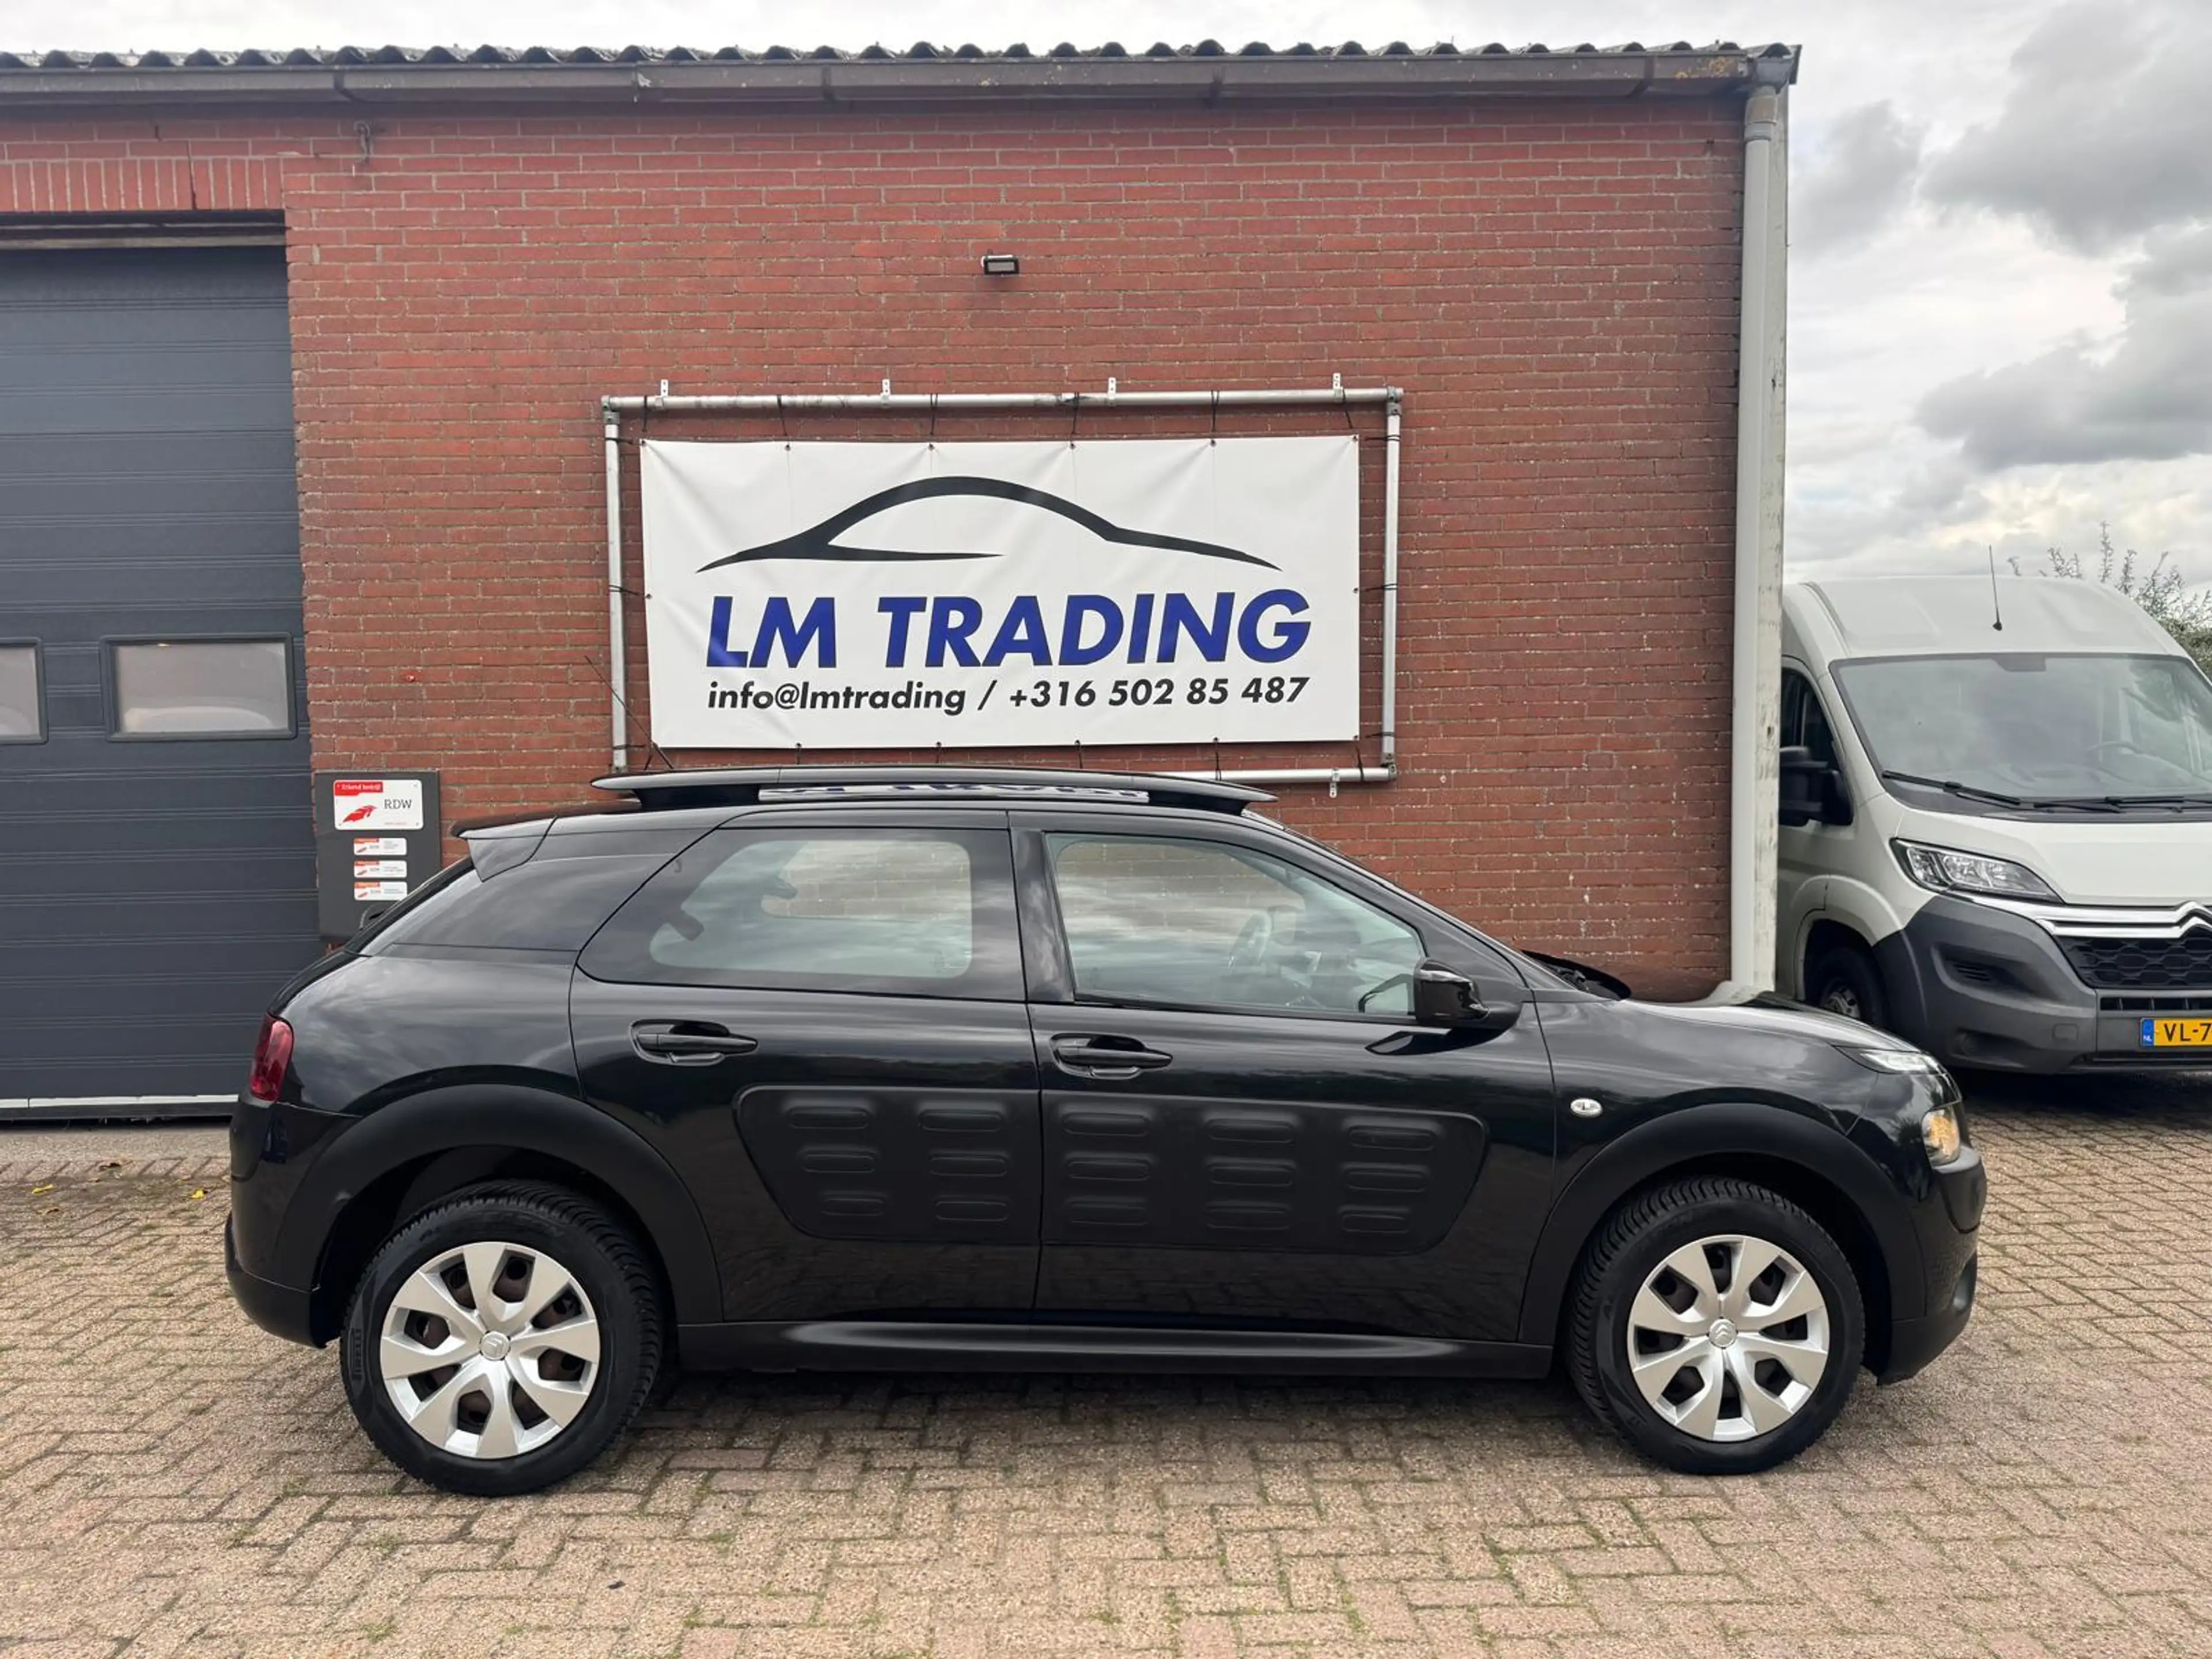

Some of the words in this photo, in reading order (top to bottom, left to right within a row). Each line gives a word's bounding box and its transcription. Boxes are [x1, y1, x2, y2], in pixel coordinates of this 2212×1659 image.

[707, 596, 836, 668] LM
[878, 589, 1309, 666] TRADING
[708, 681, 966, 716] info@lmtrading
[978, 680, 998, 710] /
[1010, 680, 1096, 707] +316
[1108, 679, 1174, 706] 502
[1187, 677, 1229, 704] 85
[1241, 676, 1310, 703] 487
[384, 799, 412, 809] RDW
[2164, 1022, 2212, 1042] VL-7
